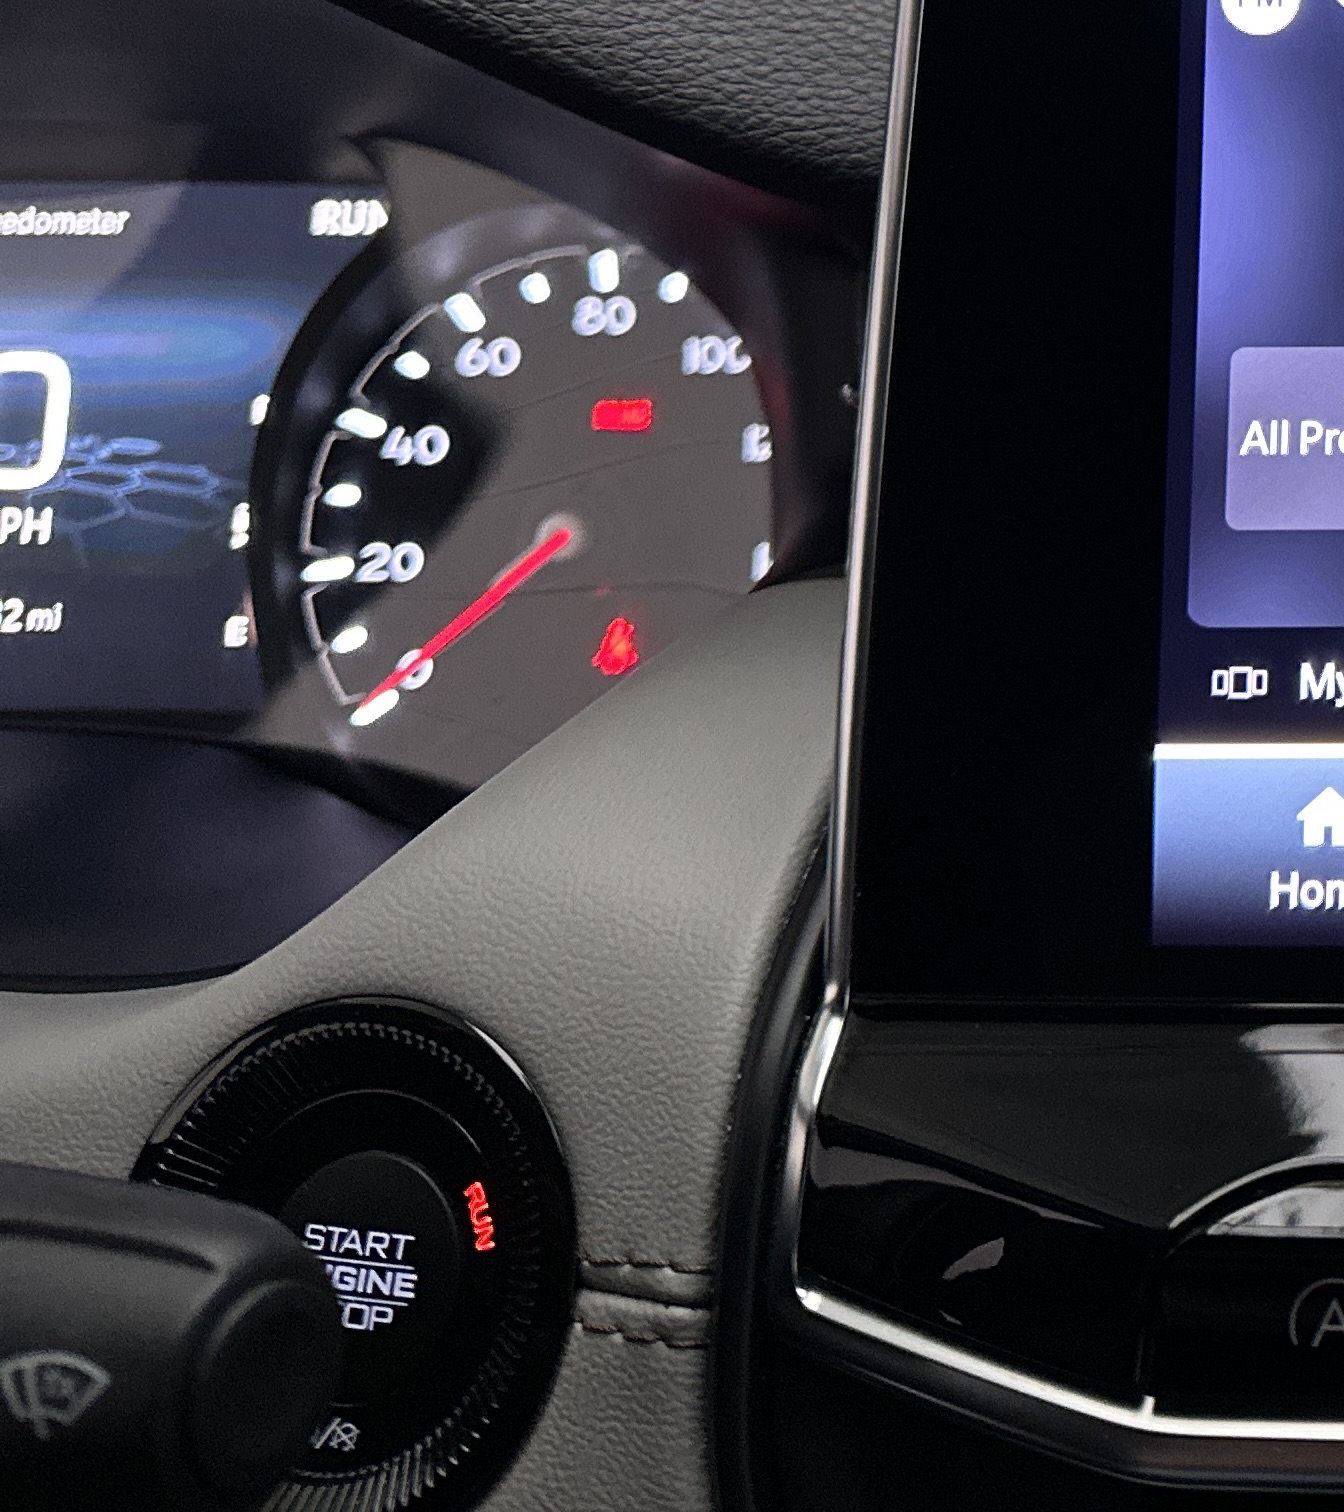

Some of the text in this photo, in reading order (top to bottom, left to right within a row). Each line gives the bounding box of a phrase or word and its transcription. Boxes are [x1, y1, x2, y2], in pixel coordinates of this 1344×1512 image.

[0, 205, 131, 236] edometer
[571, 296, 637, 336] 80
[455, 337, 521, 377] 60
[379, 424, 451, 467] 40
[1238, 417, 1290, 458] All
[356, 541, 425, 583] 20
[463, 1181, 496, 1252] RUN
[303, 1222, 417, 1261] START
[326, 1262, 419, 1300] GINE
[340, 1301, 395, 1331] OP
